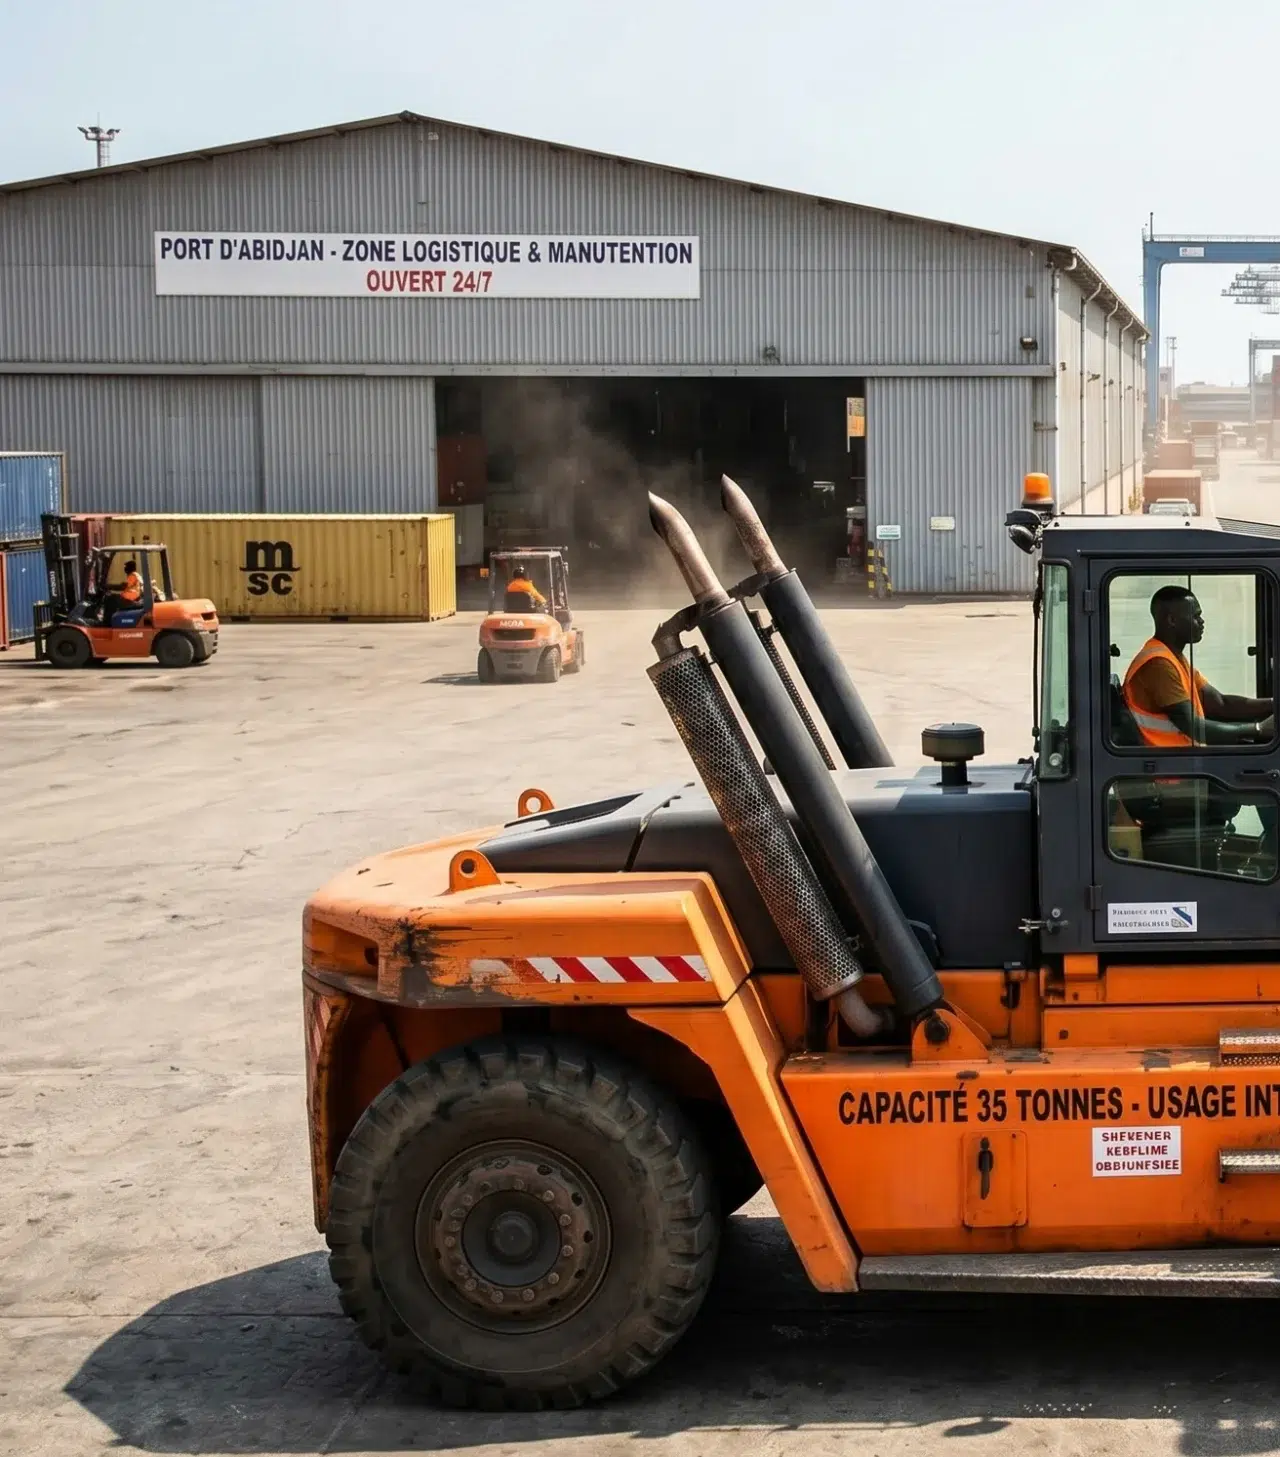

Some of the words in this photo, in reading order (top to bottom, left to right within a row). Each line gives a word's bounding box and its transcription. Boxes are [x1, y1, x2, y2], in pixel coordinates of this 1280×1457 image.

[160, 237, 214, 260] PORT
[220, 238, 324, 261] D'ABIDJAN
[342, 239, 396, 262] ZONE
[402, 240, 521, 264] LOGISTIQUE
[527, 241, 541, 263] &
[548, 241, 692, 264] MANUTENTION
[366, 269, 446, 292] OUVERT
[452, 270, 493, 293] 24/7
[838, 1083, 968, 1125] CAPACITÉ
[976, 1088, 1007, 1122] 35
[1015, 1086, 1123, 1121] TONNES
[1148, 1085, 1236, 1119] USAGE
